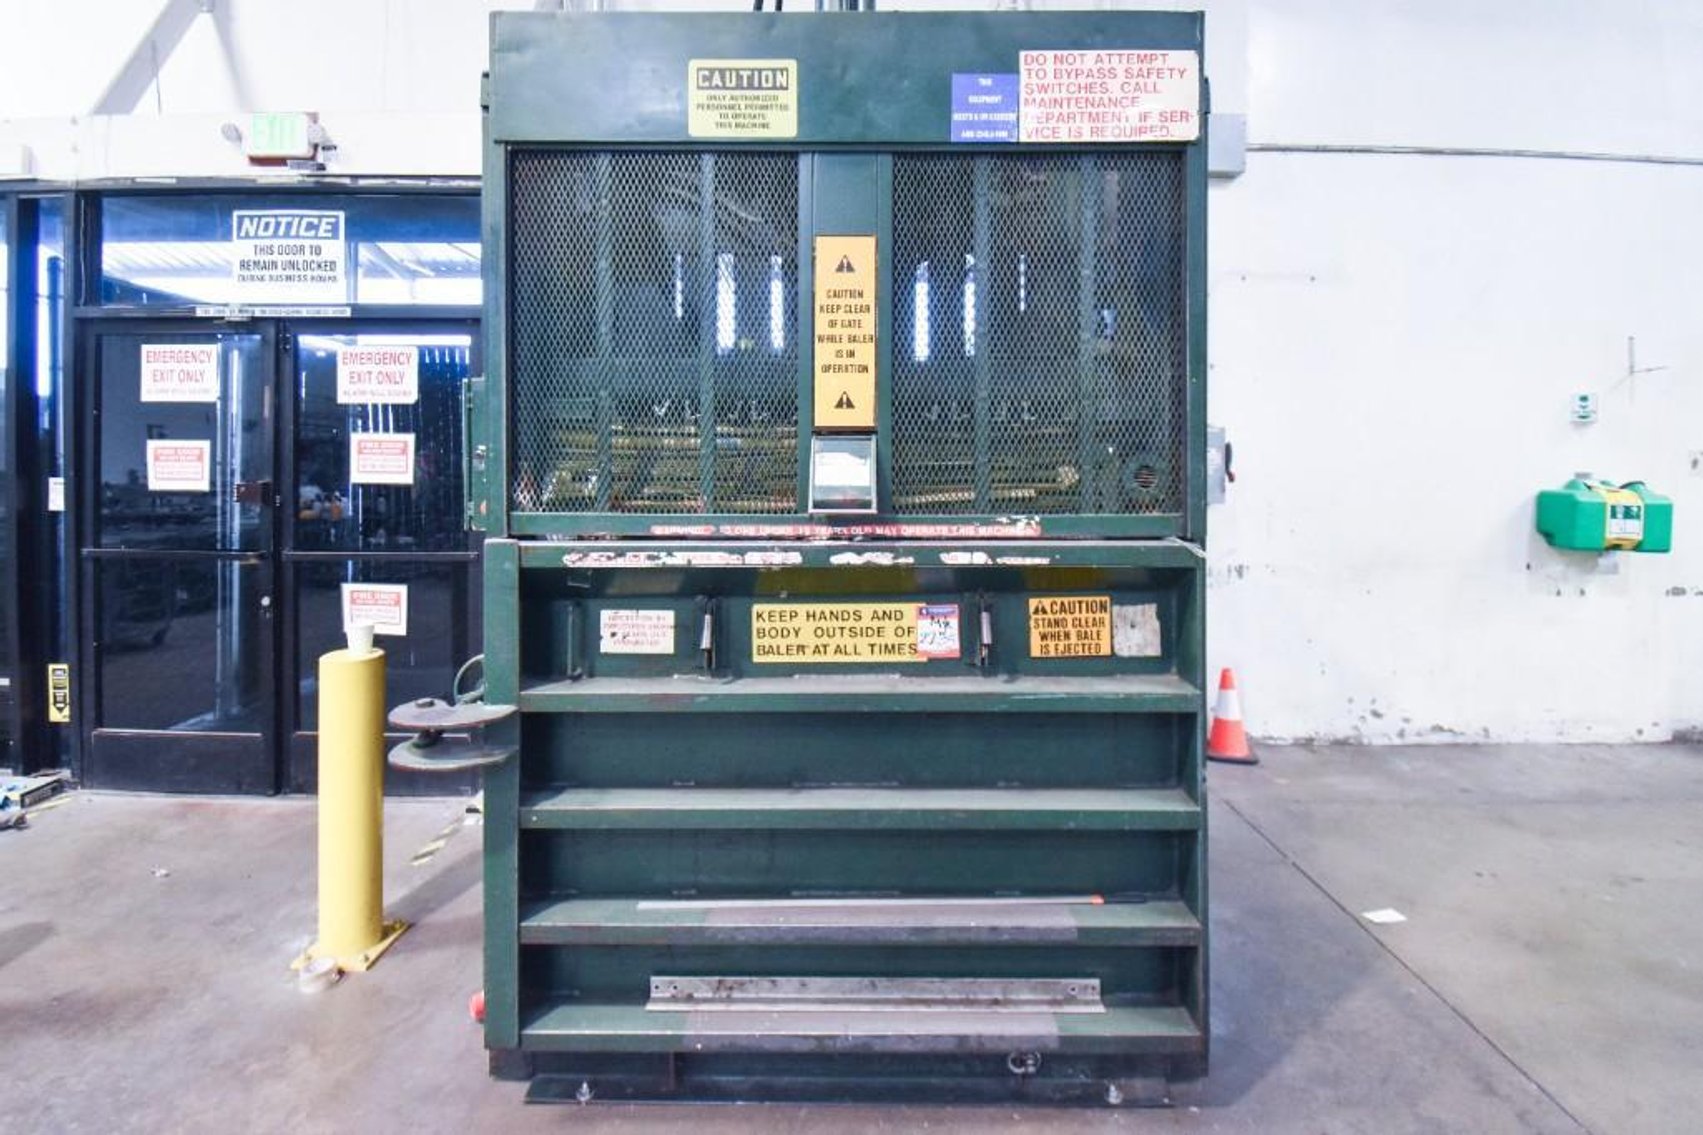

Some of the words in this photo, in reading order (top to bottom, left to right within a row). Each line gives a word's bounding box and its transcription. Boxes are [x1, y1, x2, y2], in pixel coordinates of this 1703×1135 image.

[1023, 53, 1047, 66] DO
[1053, 53, 1088, 66] NOT
[1095, 53, 1169, 65] ATTEMPT
[698, 70, 788, 88] CAUTION
[1023, 67, 1047, 80] TO
[1053, 67, 1118, 80] BYPASS
[1124, 67, 1187, 80] SAFETY
[1024, 81, 1113, 95] SWITCHES.
[1120, 81, 1163, 94] CALL
[1023, 96, 1141, 109] MAINTENANCE
[1138, 111, 1153, 123] IF
[1025, 126, 1062, 139] VICE
[1067, 126, 1084, 139] IS
[239, 216, 336, 238] NOTICE
[253, 244, 275, 257] THIS
[277, 244, 306, 257] DOOR
[309, 244, 323, 257] TO
[239, 259, 279, 272] REMAIN
[281, 259, 337, 272] UNLOCKED
[826, 288, 864, 299] CAUTION
[819, 304, 842, 314] KEEP
[844, 304, 871, 314] CLEAR
[827, 319, 838, 328] OF
[841, 319, 863, 329] GATE
[817, 334, 843, 343] WHILE
[847, 334, 874, 343] BALER
[145, 350, 213, 364] EMERGENCY
[342, 351, 413, 366] EMERGENCY
[835, 349, 844, 358] IS
[846, 349, 856, 358] IN
[820, 363, 869, 373] OPERATION
[152, 369, 175, 383] EXIT
[177, 369, 206, 383] ONLY
[348, 370, 373, 385] EXIT
[377, 370, 405, 385] ONLY
[875, 525, 898, 536] MAY
[900, 525, 950, 536] OPERATE
[951, 525, 976, 536] THIS
[1049, 600, 1108, 615] CAUTION
[755, 609, 799, 623] KEEP
[805, 609, 863, 622] HANDS
[870, 609, 904, 622] AND
[1033, 616, 1069, 630] STAND
[1071, 616, 1106, 629] CLEAR
[756, 626, 801, 640] BODY
[813, 626, 886, 639] OUTSIDE
[893, 626, 917, 638] OF
[1038, 630, 1071, 643] WHEN
[1076, 630, 1102, 642] BALE
[756, 644, 807, 656] BALER
[812, 644, 830, 656] AT
[833, 644, 862, 656] ALL
[867, 643, 918, 656] TIMES
[1039, 643, 1051, 655] IS
[1054, 643, 1102, 655] EJECTED
